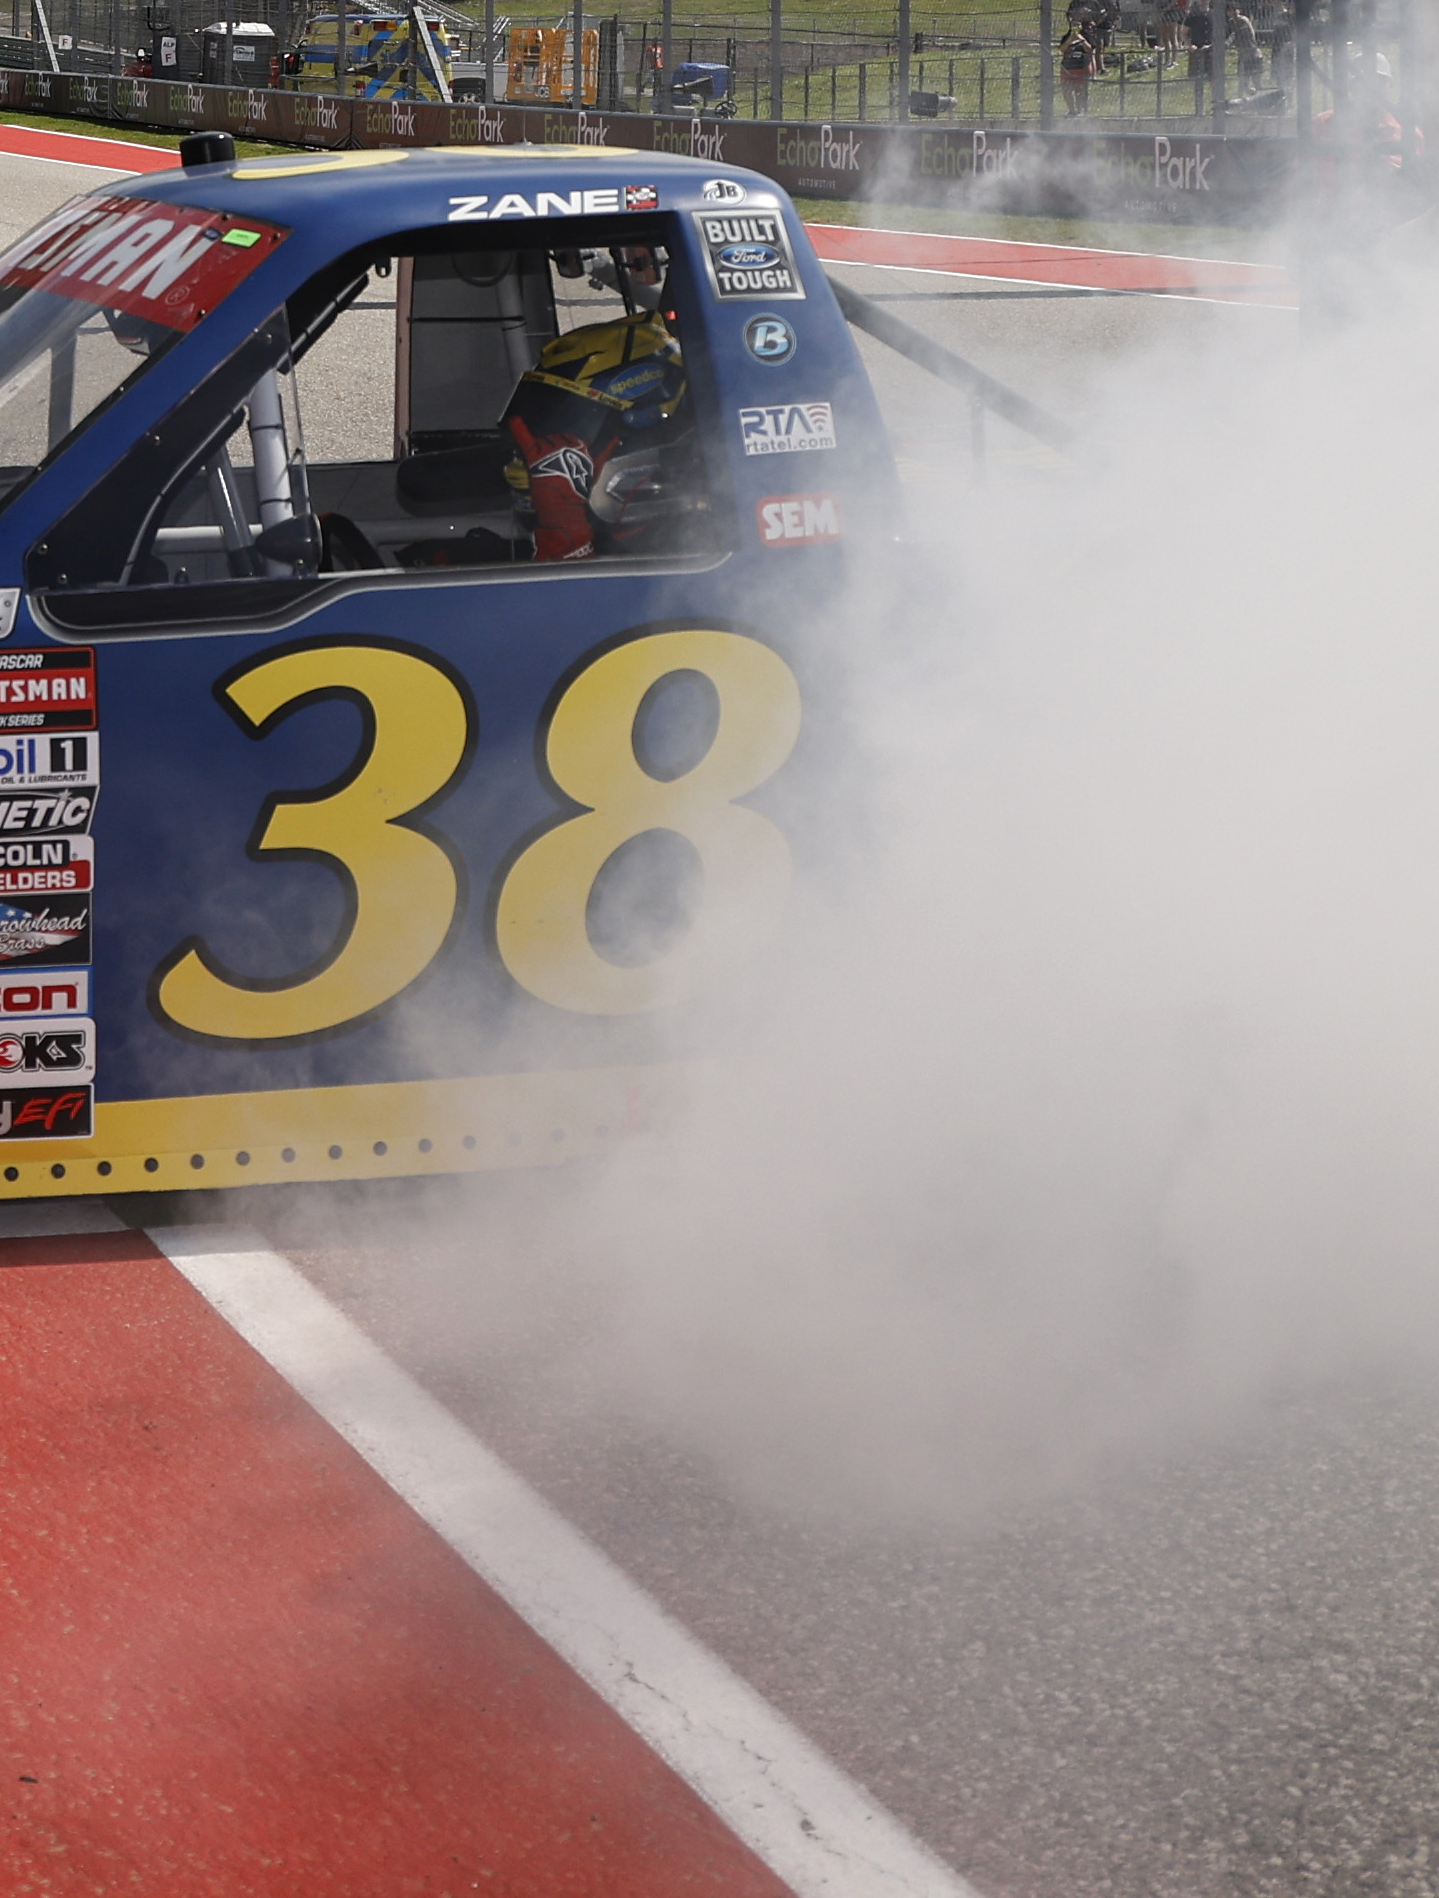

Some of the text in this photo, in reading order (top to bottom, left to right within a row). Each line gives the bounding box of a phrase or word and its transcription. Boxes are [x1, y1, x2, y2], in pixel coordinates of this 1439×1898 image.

[294, 95, 339, 130] EchoPark
[365, 101, 416, 138] EchoPark
[448, 105, 505, 144] EchoPark
[776, 124, 861, 171] EchoPark
[448, 188, 619, 222] ZANE
[705, 218, 776, 244] BUILT
[730, 247, 767, 265] Ford
[718, 269, 792, 292] TOUGH
[741, 406, 813, 439] RTA
[746, 436, 833, 453] rtatel.com
[761, 498, 841, 541] SEM
[7, 713, 45, 727] SERIES
[60, 739, 74, 771] 1
[0, 776, 15, 785] OIL
[27, 773, 87, 783] LUBRICANTS
[158, 629, 802, 1040] 38
